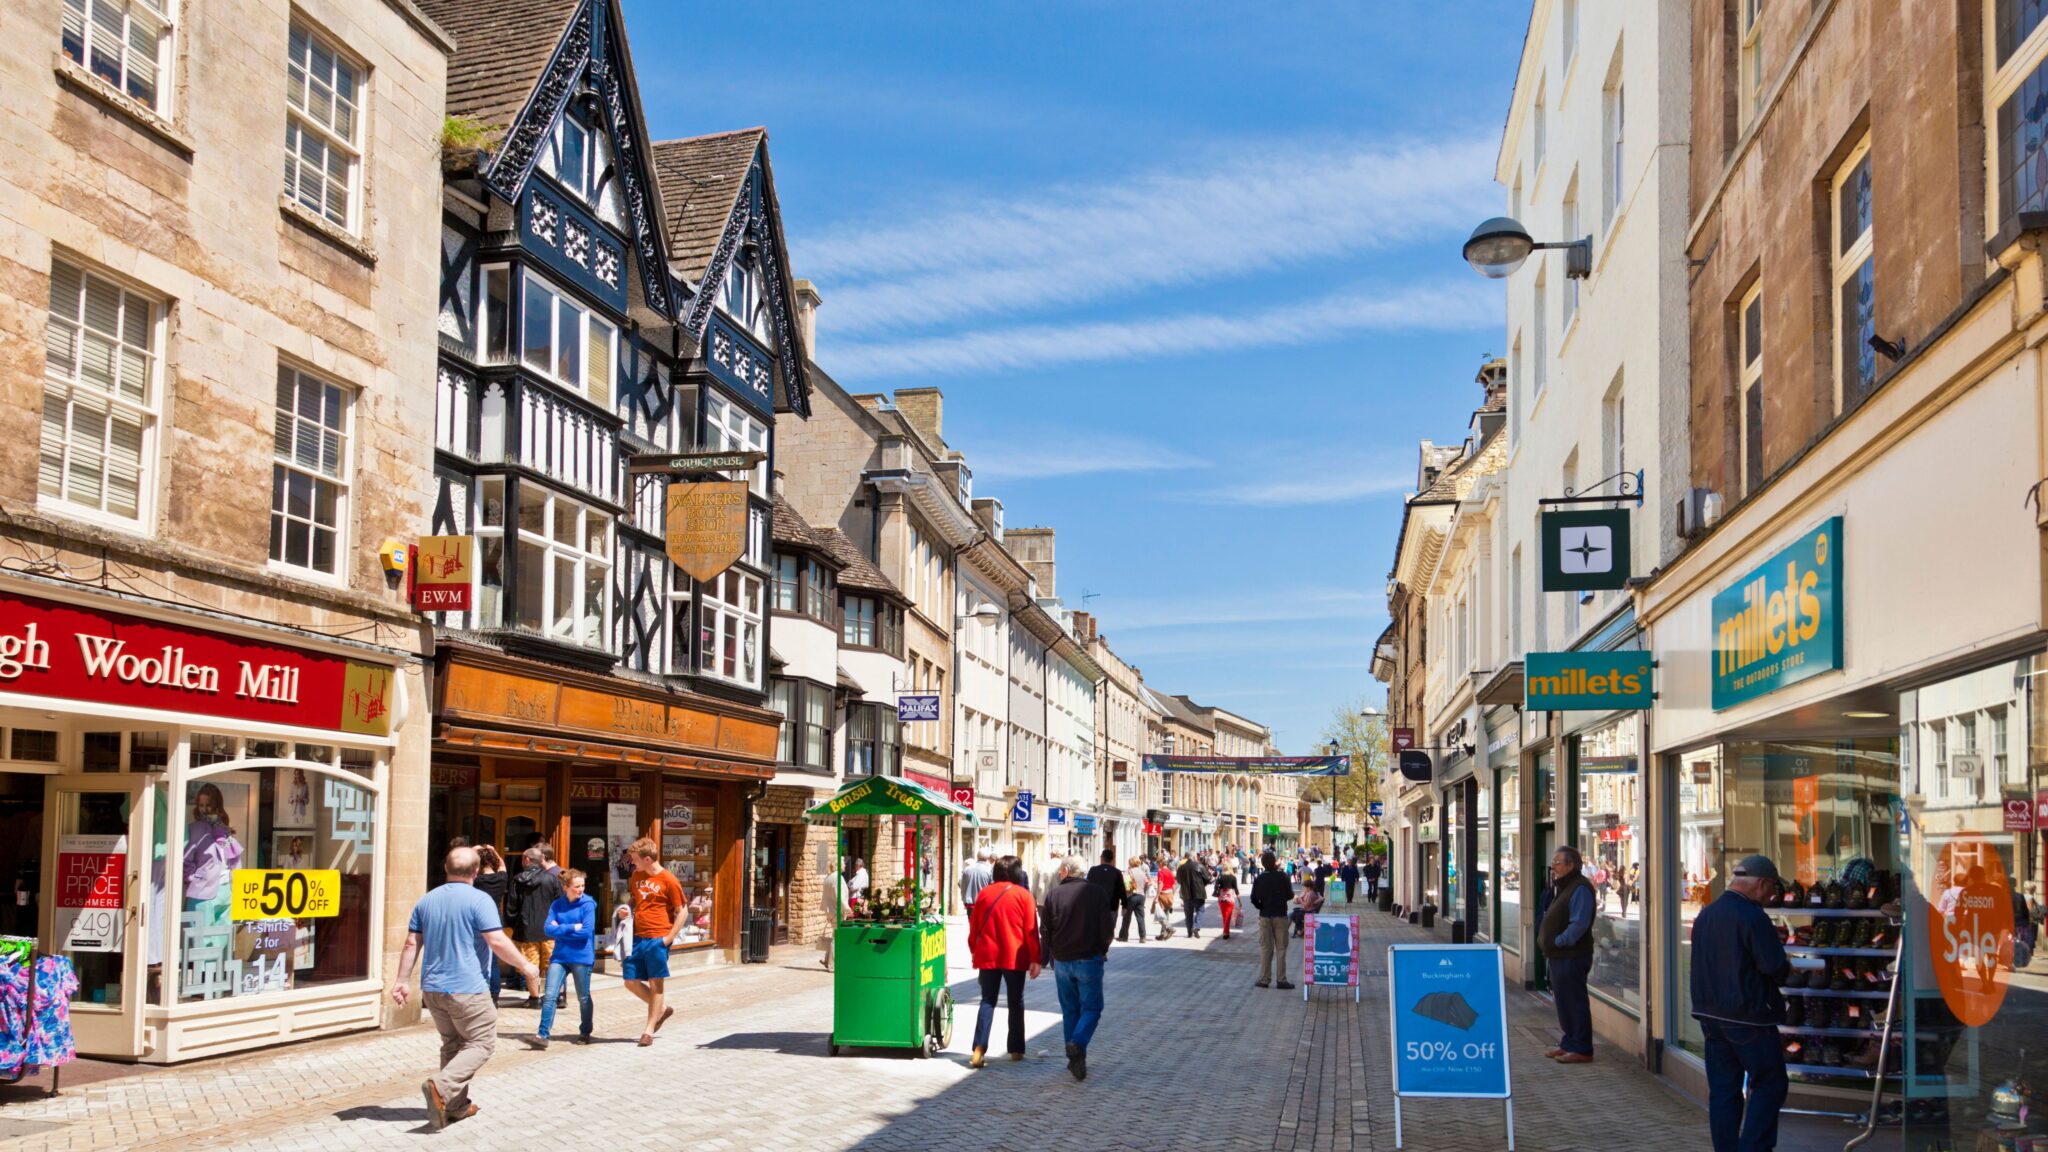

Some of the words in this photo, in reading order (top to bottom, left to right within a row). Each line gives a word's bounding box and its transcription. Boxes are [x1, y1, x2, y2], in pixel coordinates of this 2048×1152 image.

[671, 457, 706, 469] GOTHIC
[710, 456, 741, 467] HOUSE
[671, 492, 742, 507] WALKERS
[687, 505, 725, 519] BOOK
[687, 519, 726, 531] SHOP
[671, 544, 738, 554] STATIONERS
[421, 590, 463, 604] EWM
[1719, 559, 1821, 678] millets
[75, 633, 219, 693] Woollen
[235, 660, 300, 703] Mill
[1733, 678, 1745, 691] THE
[1746, 661, 1779, 685] OUTDOORS
[1781, 650, 1805, 672] STORE
[1529, 667, 1642, 696] millets
[899, 704, 938, 713] HALIFAX
[885, 783, 922, 811] Trees
[664, 810, 691, 820] MUGS
[1015, 799, 1029, 821] S
[70, 855, 116, 875] HALF
[66, 875, 120, 895] PRICE
[243, 882, 259, 894] UP
[635, 880, 662, 893] TEXAS
[64, 897, 120, 907] CASHMERE
[242, 898, 258, 910] TO
[308, 899, 329, 911] OFF
[1962, 890, 1995, 910] Season
[70, 912, 111, 937] £49
[246, 921, 290, 934] T-shirts
[255, 938, 262, 949] 2
[264, 937, 280, 948] for
[1943, 913, 1998, 968] Sale
[1422, 971, 1464, 980] Buckingham
[1406, 1041, 1458, 1061] 50%
[1463, 1042, 1496, 1059] Off
